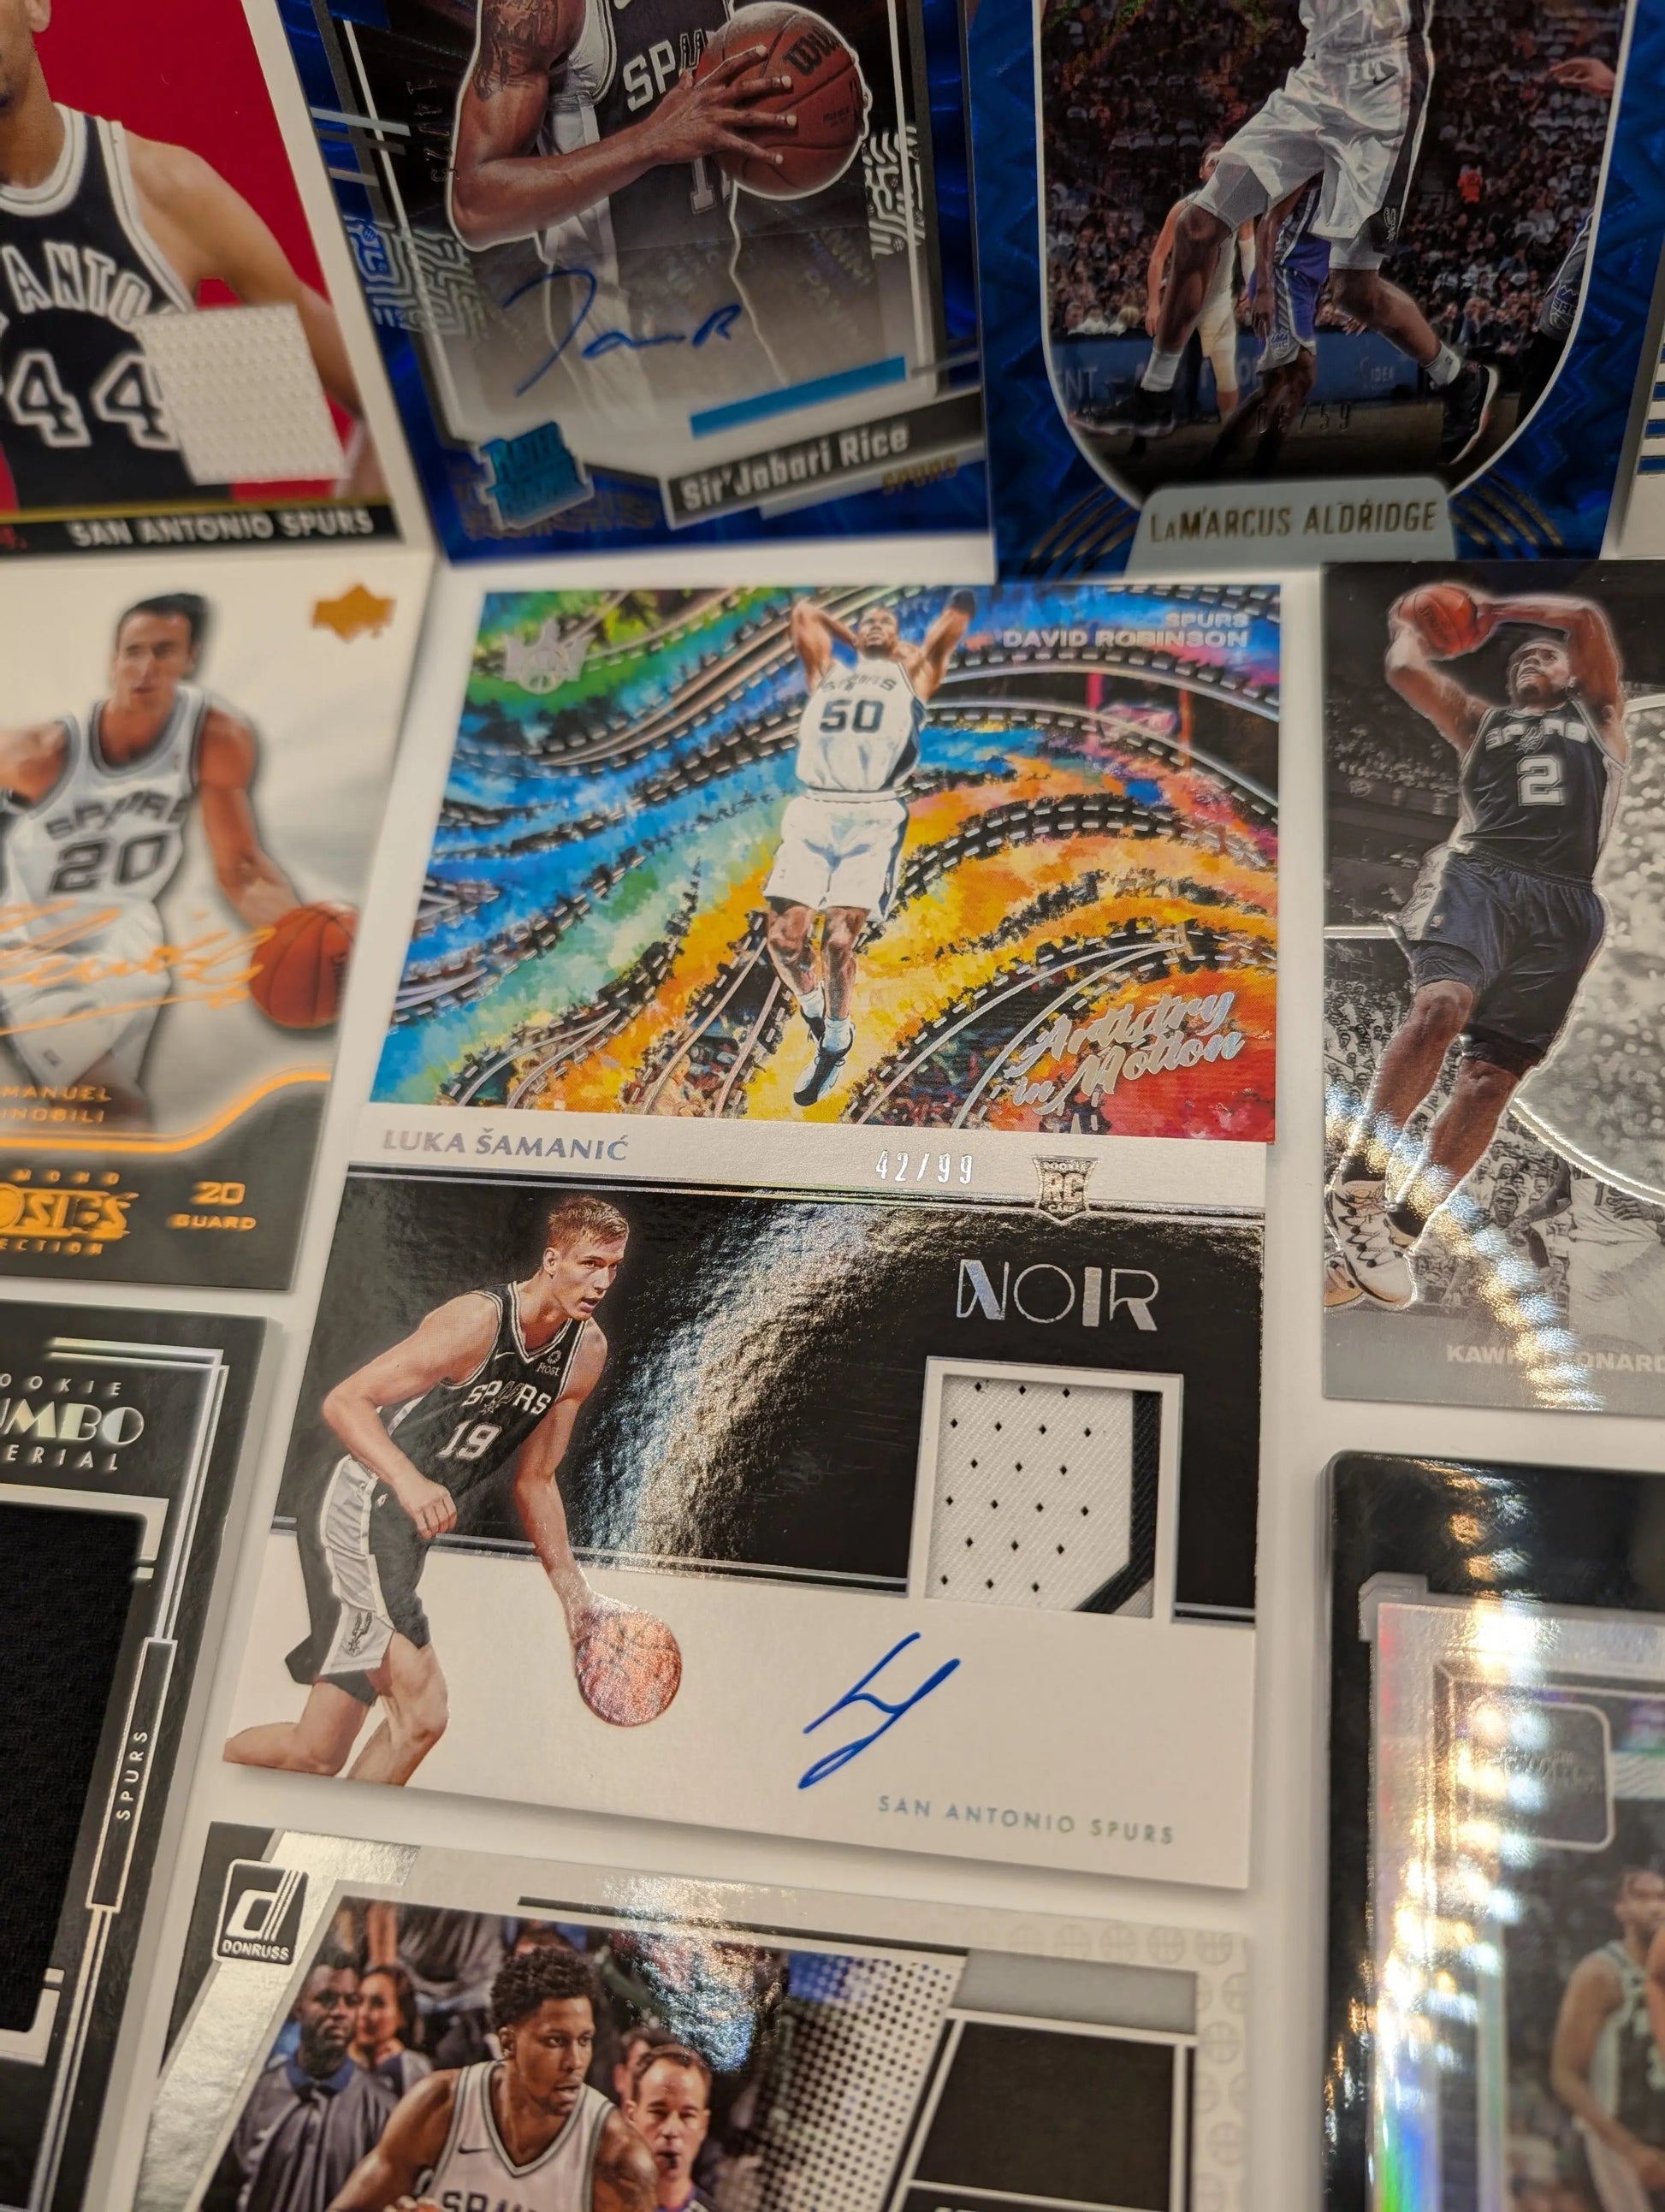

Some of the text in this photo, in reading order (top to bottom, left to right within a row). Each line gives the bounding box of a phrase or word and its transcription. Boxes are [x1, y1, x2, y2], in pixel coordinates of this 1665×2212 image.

[1, 240, 175, 332] ANTO
[7, 352, 181, 450] 44
[839, 423, 910, 466] Rice
[70, 507, 374, 546] SAN ANTONIO SPURS
[1303, 501, 1438, 536] ALDRIDGE
[1003, 629, 1248, 648] DAVID ROBINSON
[1165, 611, 1249, 628] SPURS
[819, 699, 884, 733] 50
[1516, 756, 1565, 806] 2
[48, 833, 170, 895] 20
[1003, 992, 1235, 1078] Artistry
[1013, 1031, 1246, 1115] in Motion
[383, 1127, 630, 1160] LUKA ŠAMANIĆ
[876, 1149, 973, 1184] 42/99
[189, 1181, 246, 1206] 20
[1043, 1172, 1084, 1202] RC
[168, 1213, 257, 1231] GUARD
[956, 1259, 1159, 1331] NOIR
[460, 1379, 552, 1415] SPURS
[435, 1419, 502, 1460] 19
[116, 1731, 148, 1821] SPURS
[878, 1794, 1175, 1845] SAN ANTONIO SPURS
[222, 1938, 290, 1961] DONRUSS
